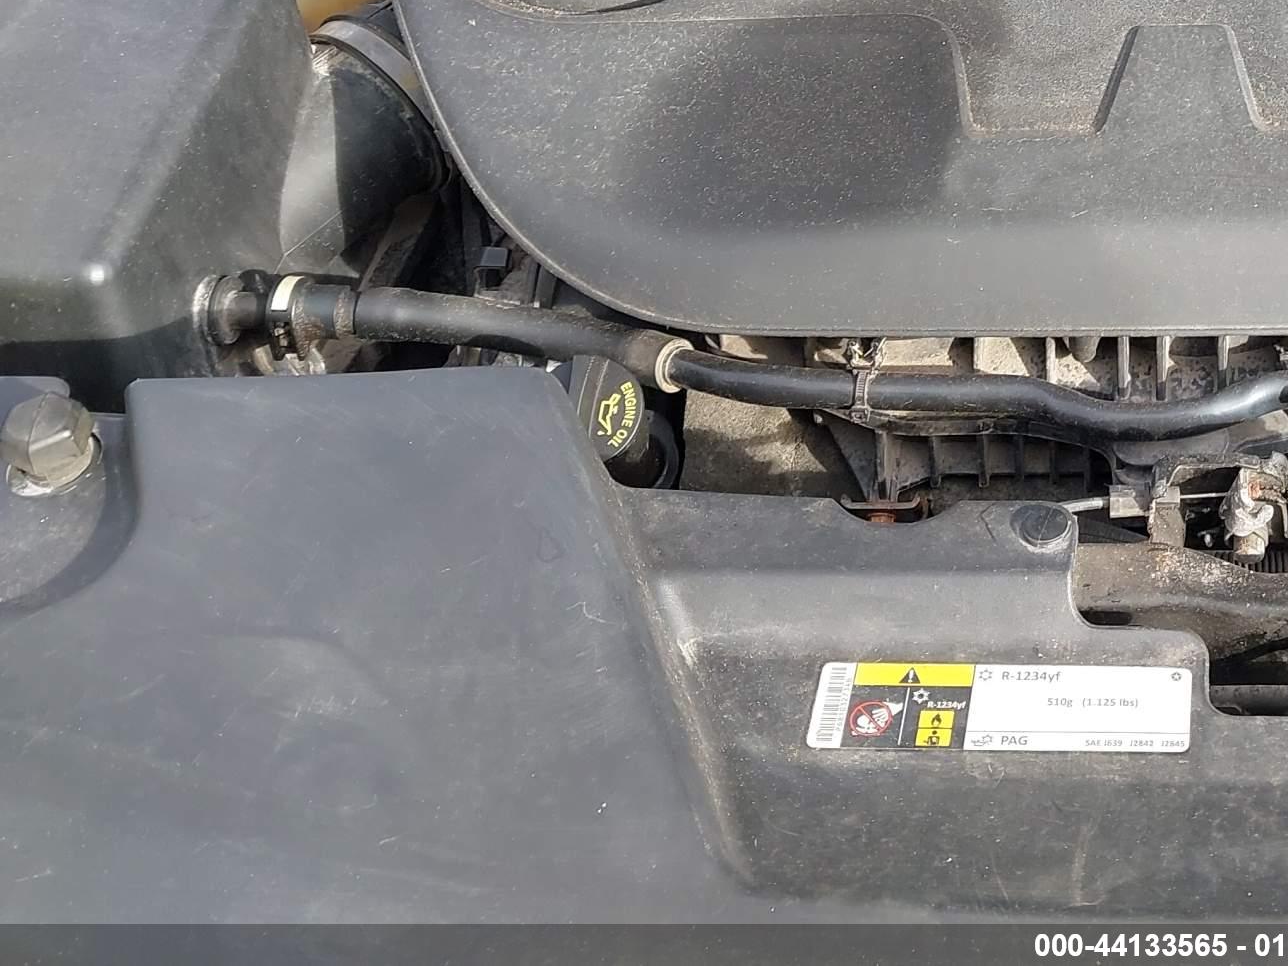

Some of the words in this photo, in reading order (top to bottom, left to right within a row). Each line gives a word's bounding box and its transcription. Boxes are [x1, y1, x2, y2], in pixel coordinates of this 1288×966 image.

[620, 381, 638, 428] ENGINE
[607, 428, 628, 448] OIL
[1001, 671, 1063, 683] R-1234yf
[927, 700, 967, 710] R-1234yf
[1047, 697, 1073, 708] 510g
[1082, 697, 1116, 708] (1.125
[1119, 697, 1139, 708] lbs)
[1000, 735, 1029, 747] PAG
[1085, 739, 1100, 747] SAE
